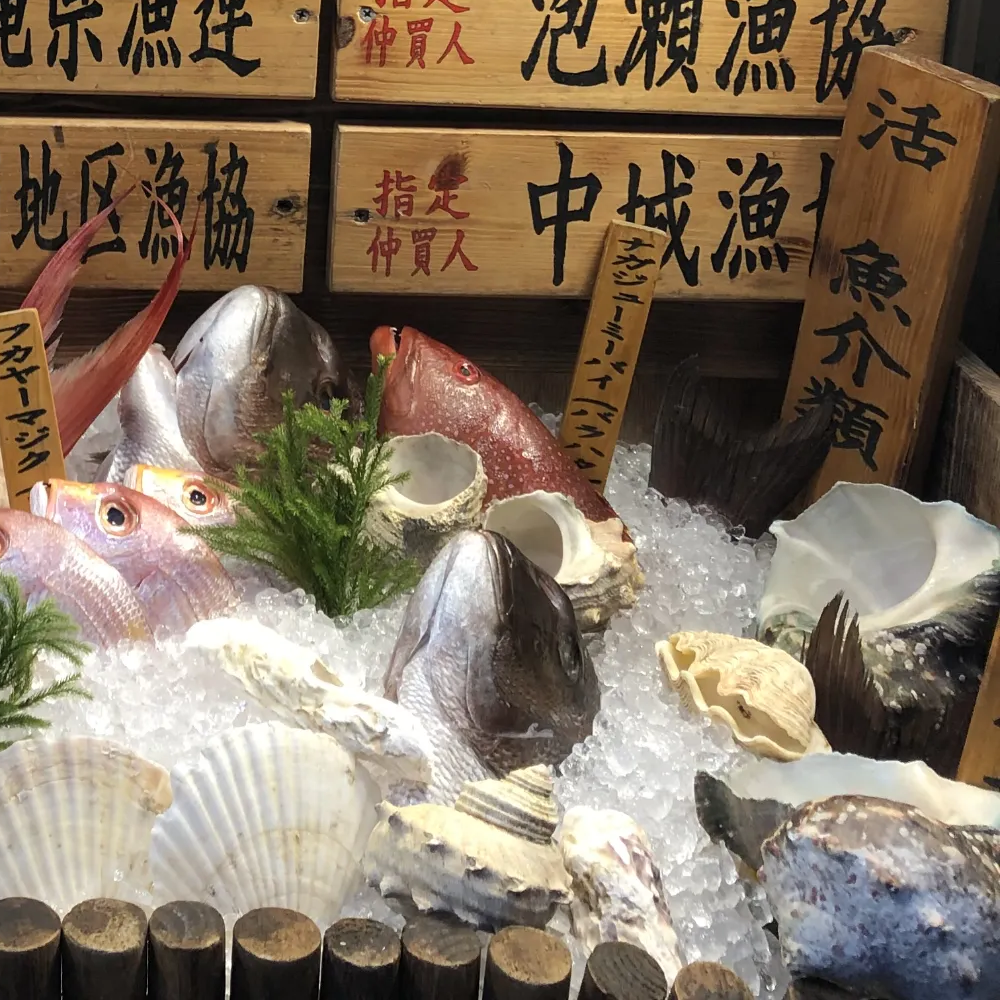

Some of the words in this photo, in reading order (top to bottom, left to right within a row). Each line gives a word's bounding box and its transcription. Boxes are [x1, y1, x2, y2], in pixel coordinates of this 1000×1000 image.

[361, 17, 476, 70] 仲買人
[372, 169, 472, 218] 指定
[366, 228, 479, 278] 仲買人
